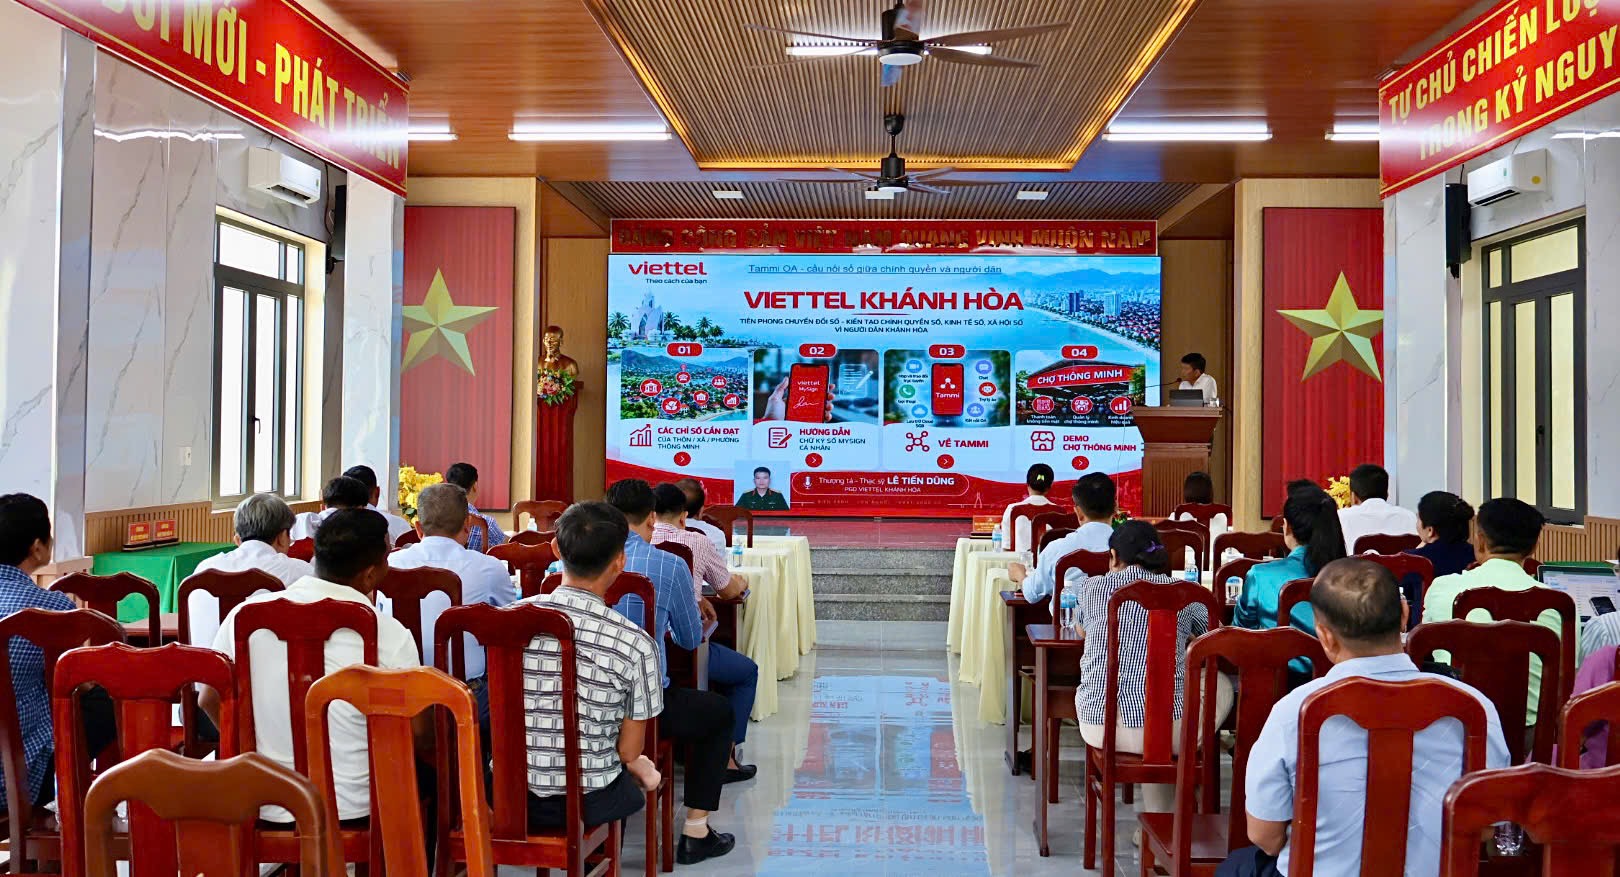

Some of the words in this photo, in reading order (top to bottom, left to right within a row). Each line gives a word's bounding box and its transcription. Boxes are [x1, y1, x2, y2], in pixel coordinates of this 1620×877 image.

[1389, 83, 1412, 125] TỰ
[1416, 51, 1456, 110] CHỦ
[1462, 7, 1538, 82] CHIẾN
[1495, 65, 1527, 124] KỶ
[1535, 24, 1618, 103] NGUY
[275, 43, 338, 133] PHÁT
[975, 229, 1024, 248] VINH
[1031, 226, 1094, 249] MUÔN
[1101, 226, 1151, 249] NĂM
[628, 261, 708, 276] viettel
[748, 264, 780, 273] Tammi
[782, 264, 798, 273] OA
[880, 264, 906, 273] chính
[940, 264, 951, 273] và
[953, 264, 982, 275] người
[695, 278, 708, 286] bạn
[743, 291, 856, 309] VIETTEL
[860, 287, 957, 310] KHÁNH
[963, 287, 1025, 311] HÒA
[677, 346, 691, 354] 01
[809, 346, 825, 355] 02
[939, 347, 955, 356] 03
[1071, 348, 1088, 357] 04
[1037, 375, 1056, 384] CHỢ
[1058, 371, 1091, 382] THÔNG
[1093, 369, 1123, 379] MINH
[657, 426, 674, 435] CÁC
[722, 428, 740, 437] ĐẠT
[799, 427, 831, 436] HƯỚNG
[953, 439, 989, 448] TAMMI
[1062, 443, 1081, 452] CHỢ
[1082, 443, 1112, 451] THÔNG
[1113, 444, 1137, 452] MINH
[818, 476, 845, 485] Thượng
[887, 474, 899, 485] LÊ
[901, 474, 924, 485] TIẾN
[926, 475, 955, 485] DŨNG
